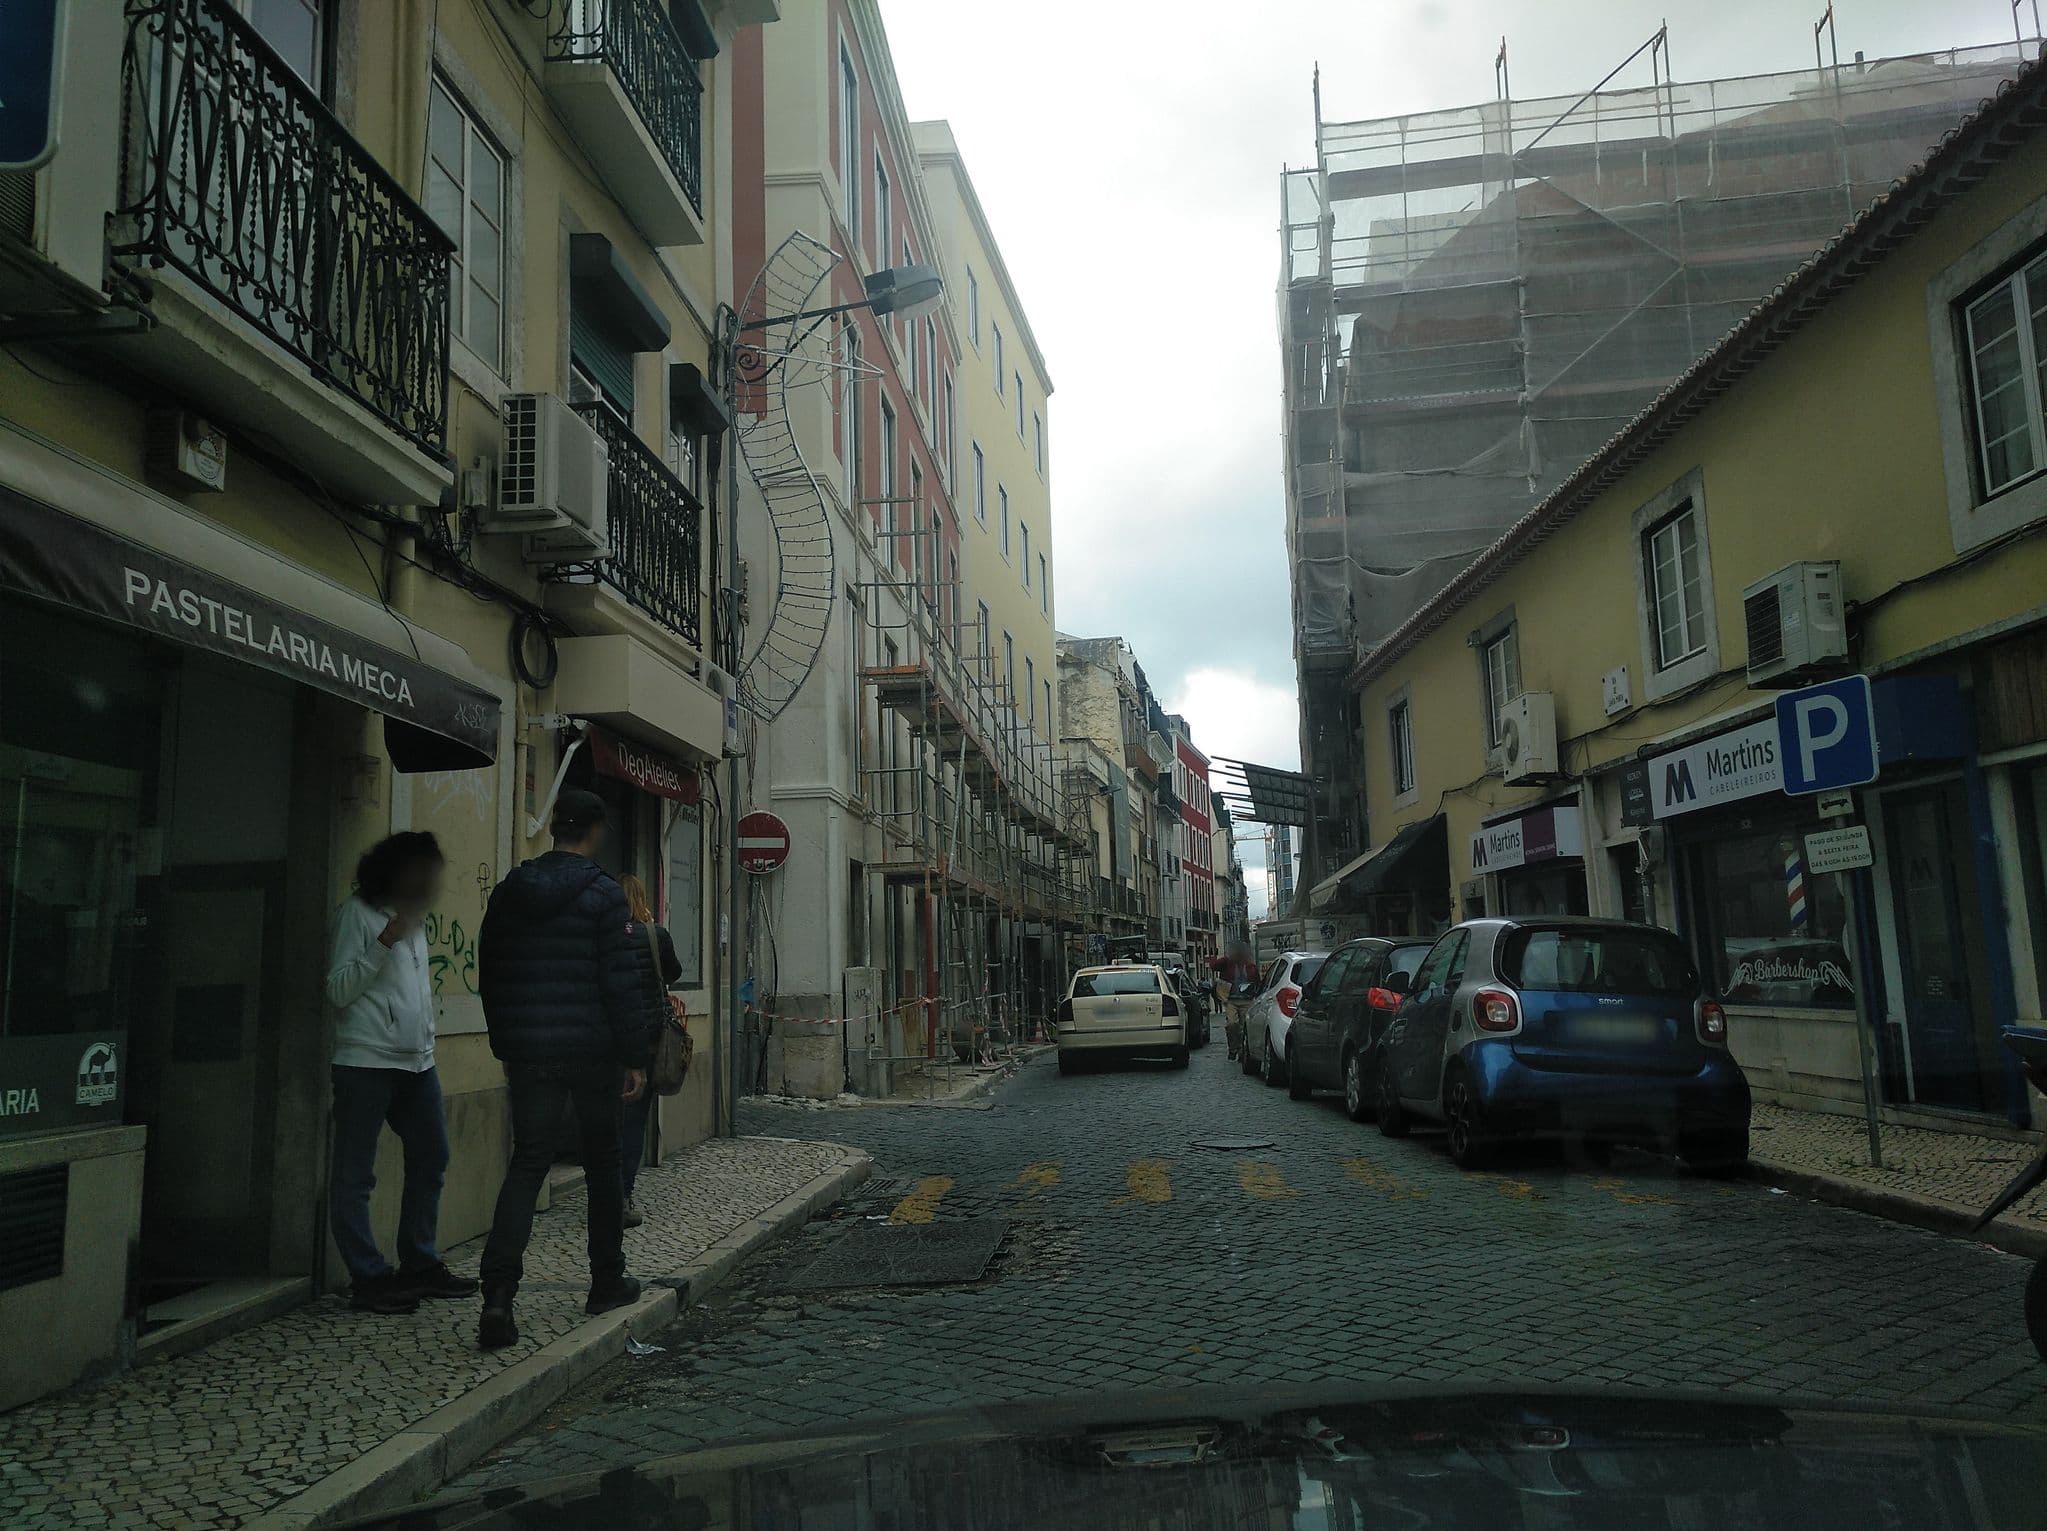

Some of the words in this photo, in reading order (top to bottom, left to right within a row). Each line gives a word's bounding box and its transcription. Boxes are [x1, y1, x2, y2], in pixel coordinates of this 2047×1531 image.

[123, 566, 338, 678] PASTELARIA
[342, 653, 415, 708] MECA
[1794, 694, 1849, 783] P
[617, 741, 682, 792] DegAtelier
[1706, 738, 1775, 780] Martins
[1709, 769, 1777, 796] CABELEIREIROS
[1489, 830, 1520, 854] Martins
[1809, 837, 1825, 845] PAGO
[1835, 831, 1863, 842] SEUNDA
[1754, 957, 1818, 990] Barbershop
[1598, 996, 1624, 1006] smart
[79, 1087, 113, 1099] CAMELO
